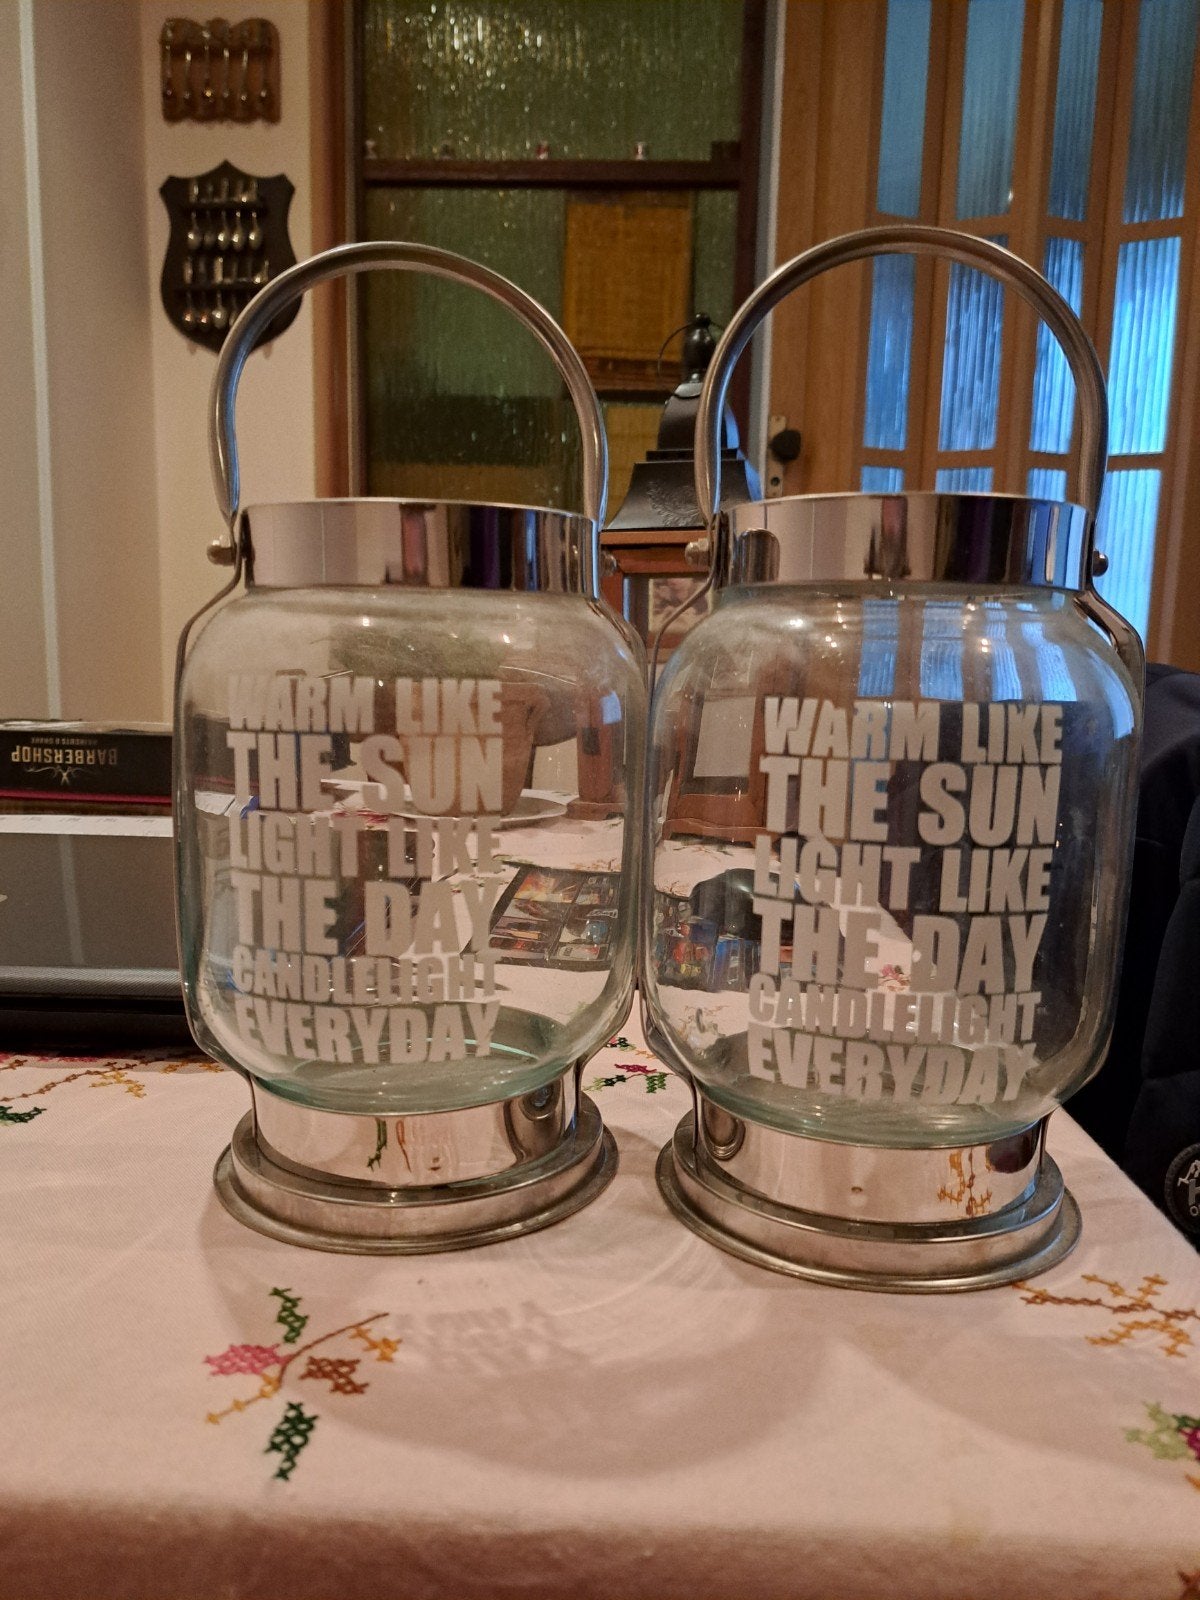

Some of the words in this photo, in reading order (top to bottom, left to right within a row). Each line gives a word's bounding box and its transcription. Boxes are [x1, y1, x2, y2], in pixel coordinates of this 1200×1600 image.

[226, 676, 375, 733] WARM
[395, 676, 503, 734] LIKE
[763, 697, 940, 760] WARM
[961, 703, 1063, 764] LIKE
[11, 745, 117, 765] BARBERSHOP
[227, 733, 332, 810] THE
[360, 735, 504, 814] SUN
[759, 756, 890, 842] THE
[918, 763, 1062, 847] SUN
[229, 809, 362, 877] LIGHT
[387, 815, 502, 881] LIKE
[753, 835, 921, 911] LIGHT
[939, 848, 1054, 912] LIKE
[229, 872, 340, 954] THE
[364, 877, 502, 955] DAY
[753, 898, 882, 990] THE
[910, 914, 1048, 995] DAY
[232, 945, 499, 1001] CANDLELIGHT
[748, 973, 1042, 1043] CANDLELIGHT
[234, 998, 501, 1064] EVERYDAY
[747, 1022, 1037, 1106] EVERYDAY
